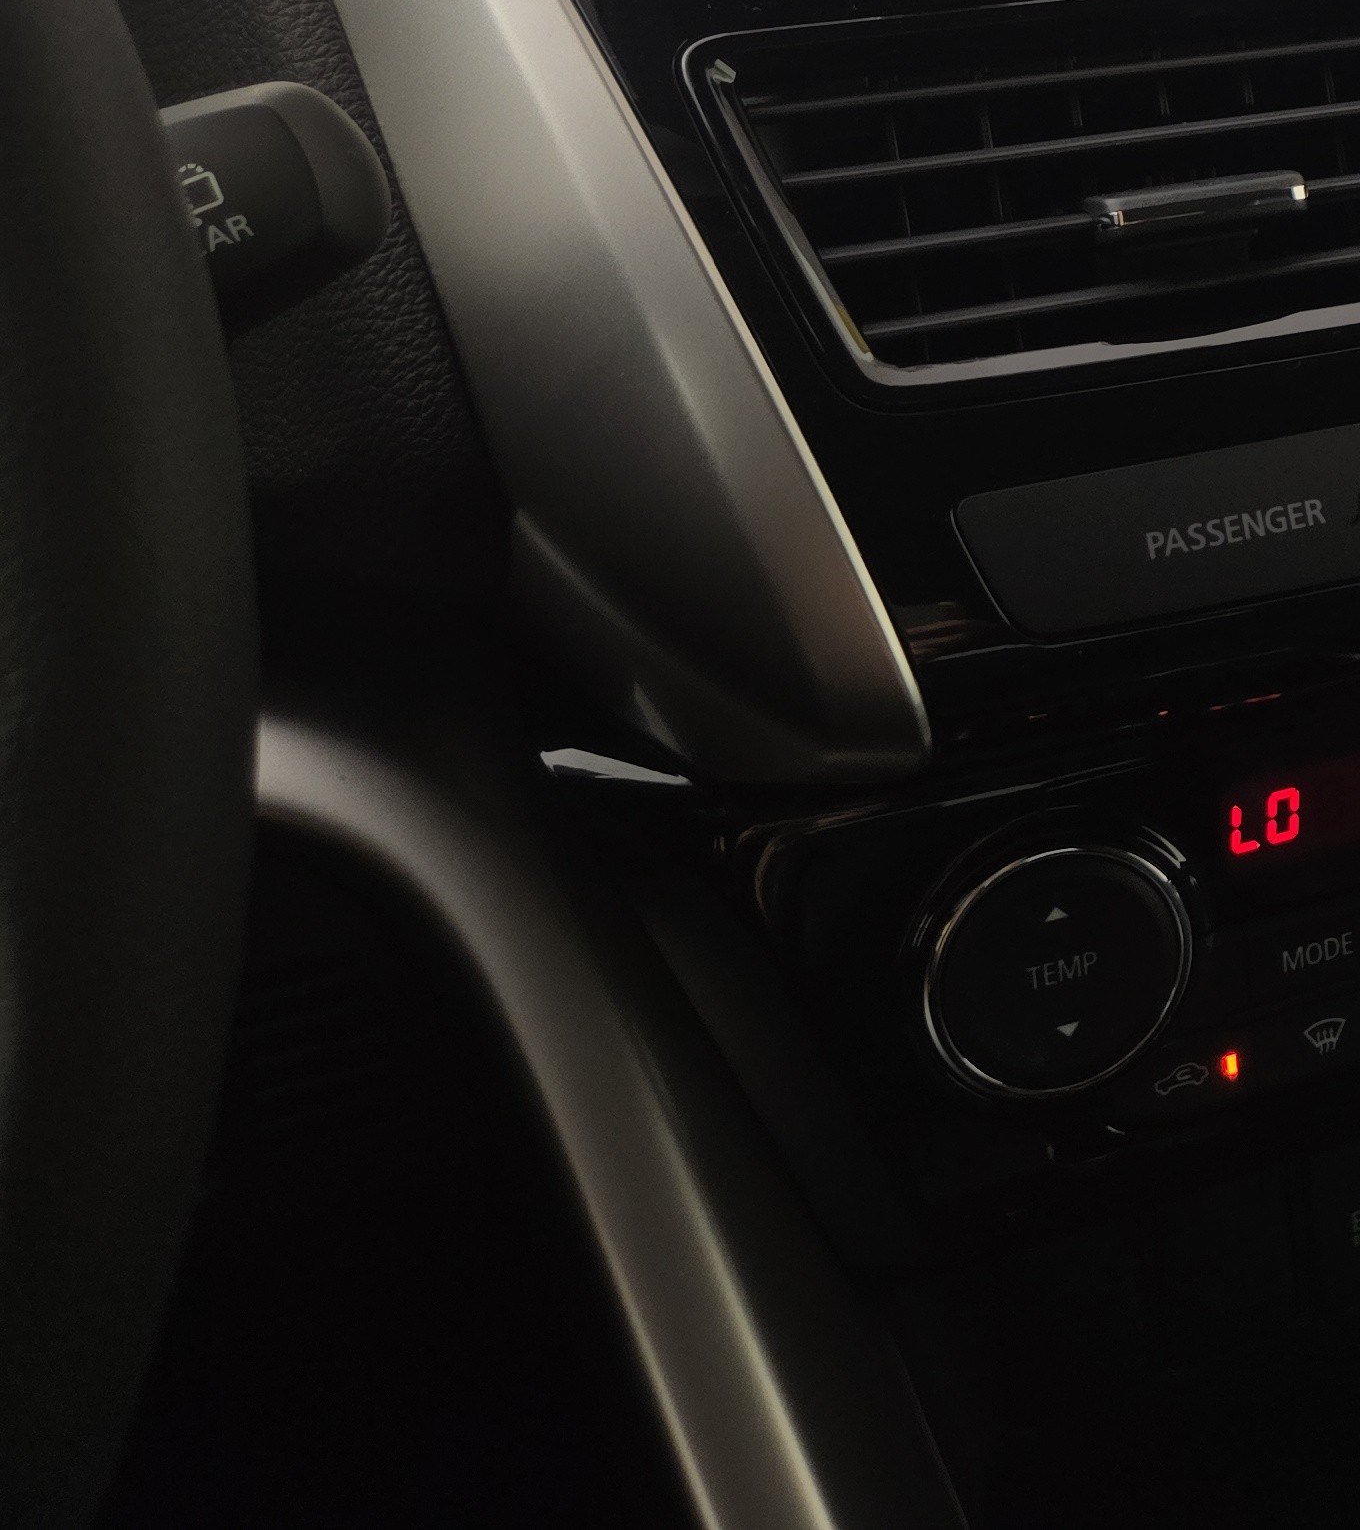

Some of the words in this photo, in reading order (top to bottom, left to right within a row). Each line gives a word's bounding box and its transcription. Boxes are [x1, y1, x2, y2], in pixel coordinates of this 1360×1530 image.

[1146, 499, 1324, 557] PASSENGER
[1026, 949, 1099, 991] TEMP
[1280, 930, 1355, 973] MODE
